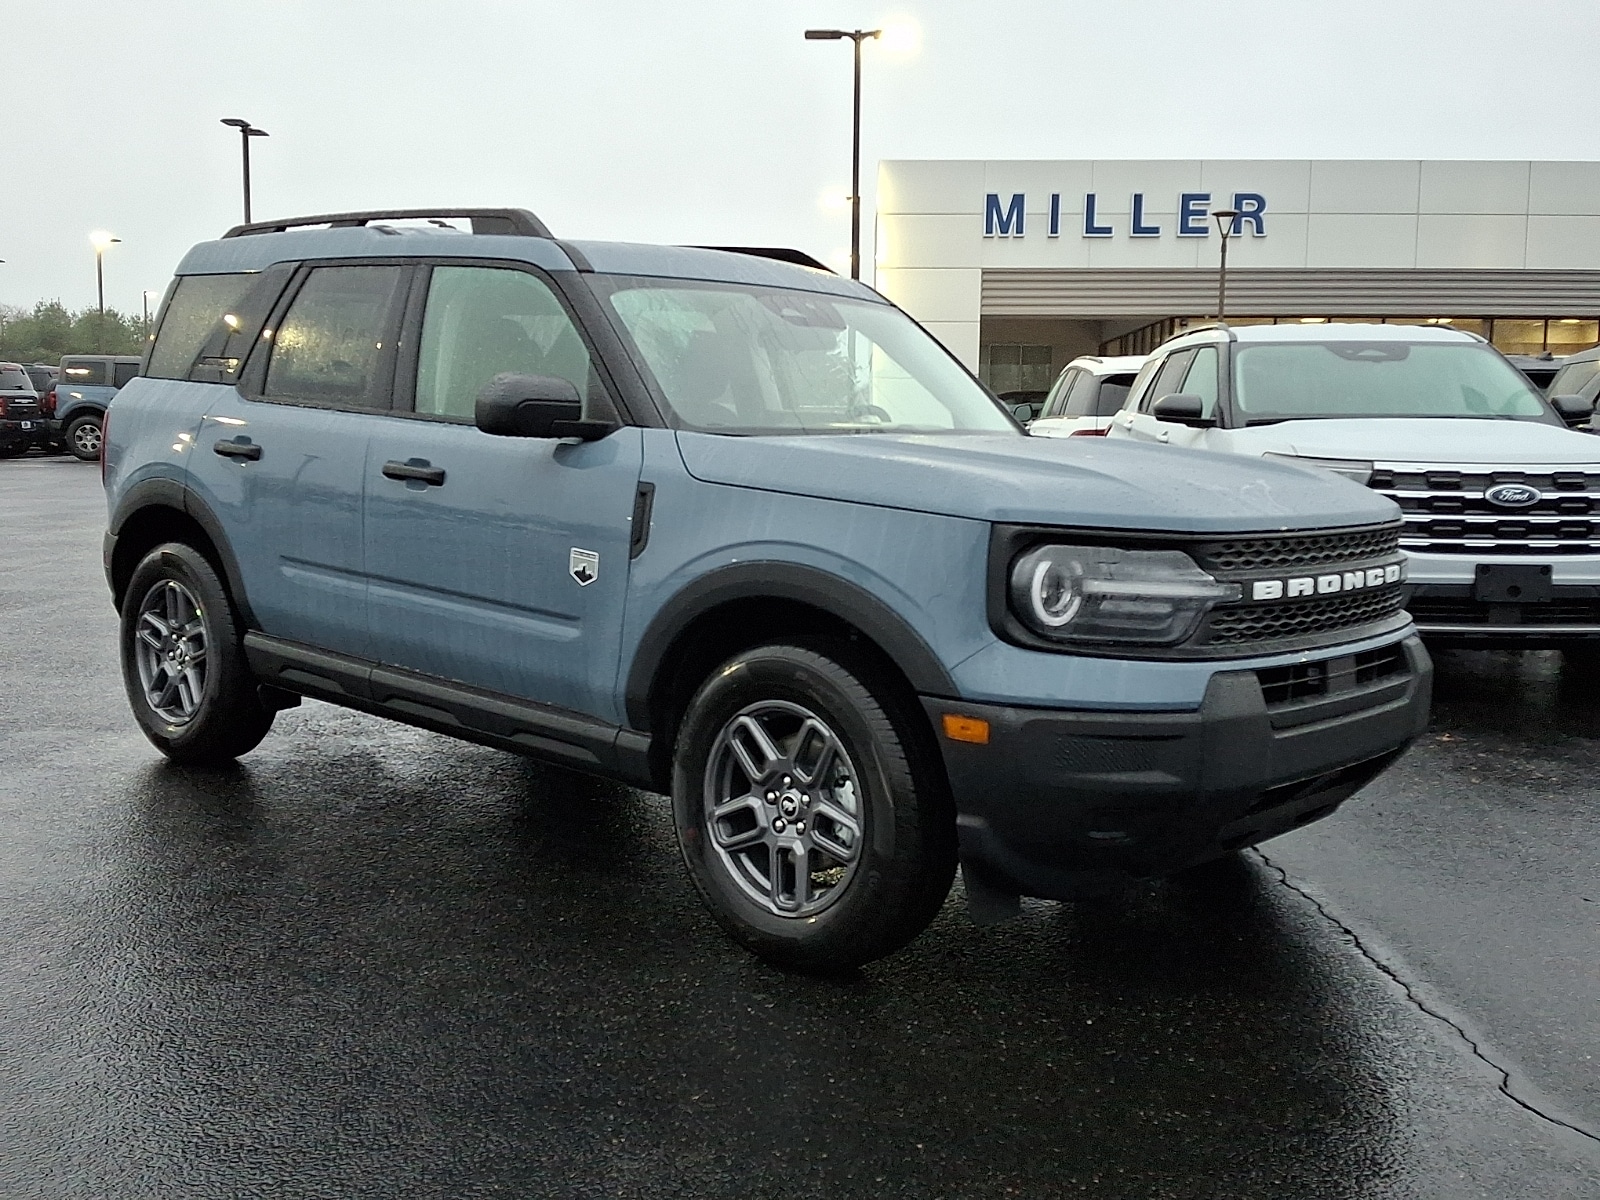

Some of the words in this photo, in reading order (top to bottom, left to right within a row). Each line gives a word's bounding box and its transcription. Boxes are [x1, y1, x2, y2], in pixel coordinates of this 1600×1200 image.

[983, 192, 1267, 238] MILLER
[1498, 488, 1531, 501] Ford
[1252, 564, 1401, 601] BRONCO
